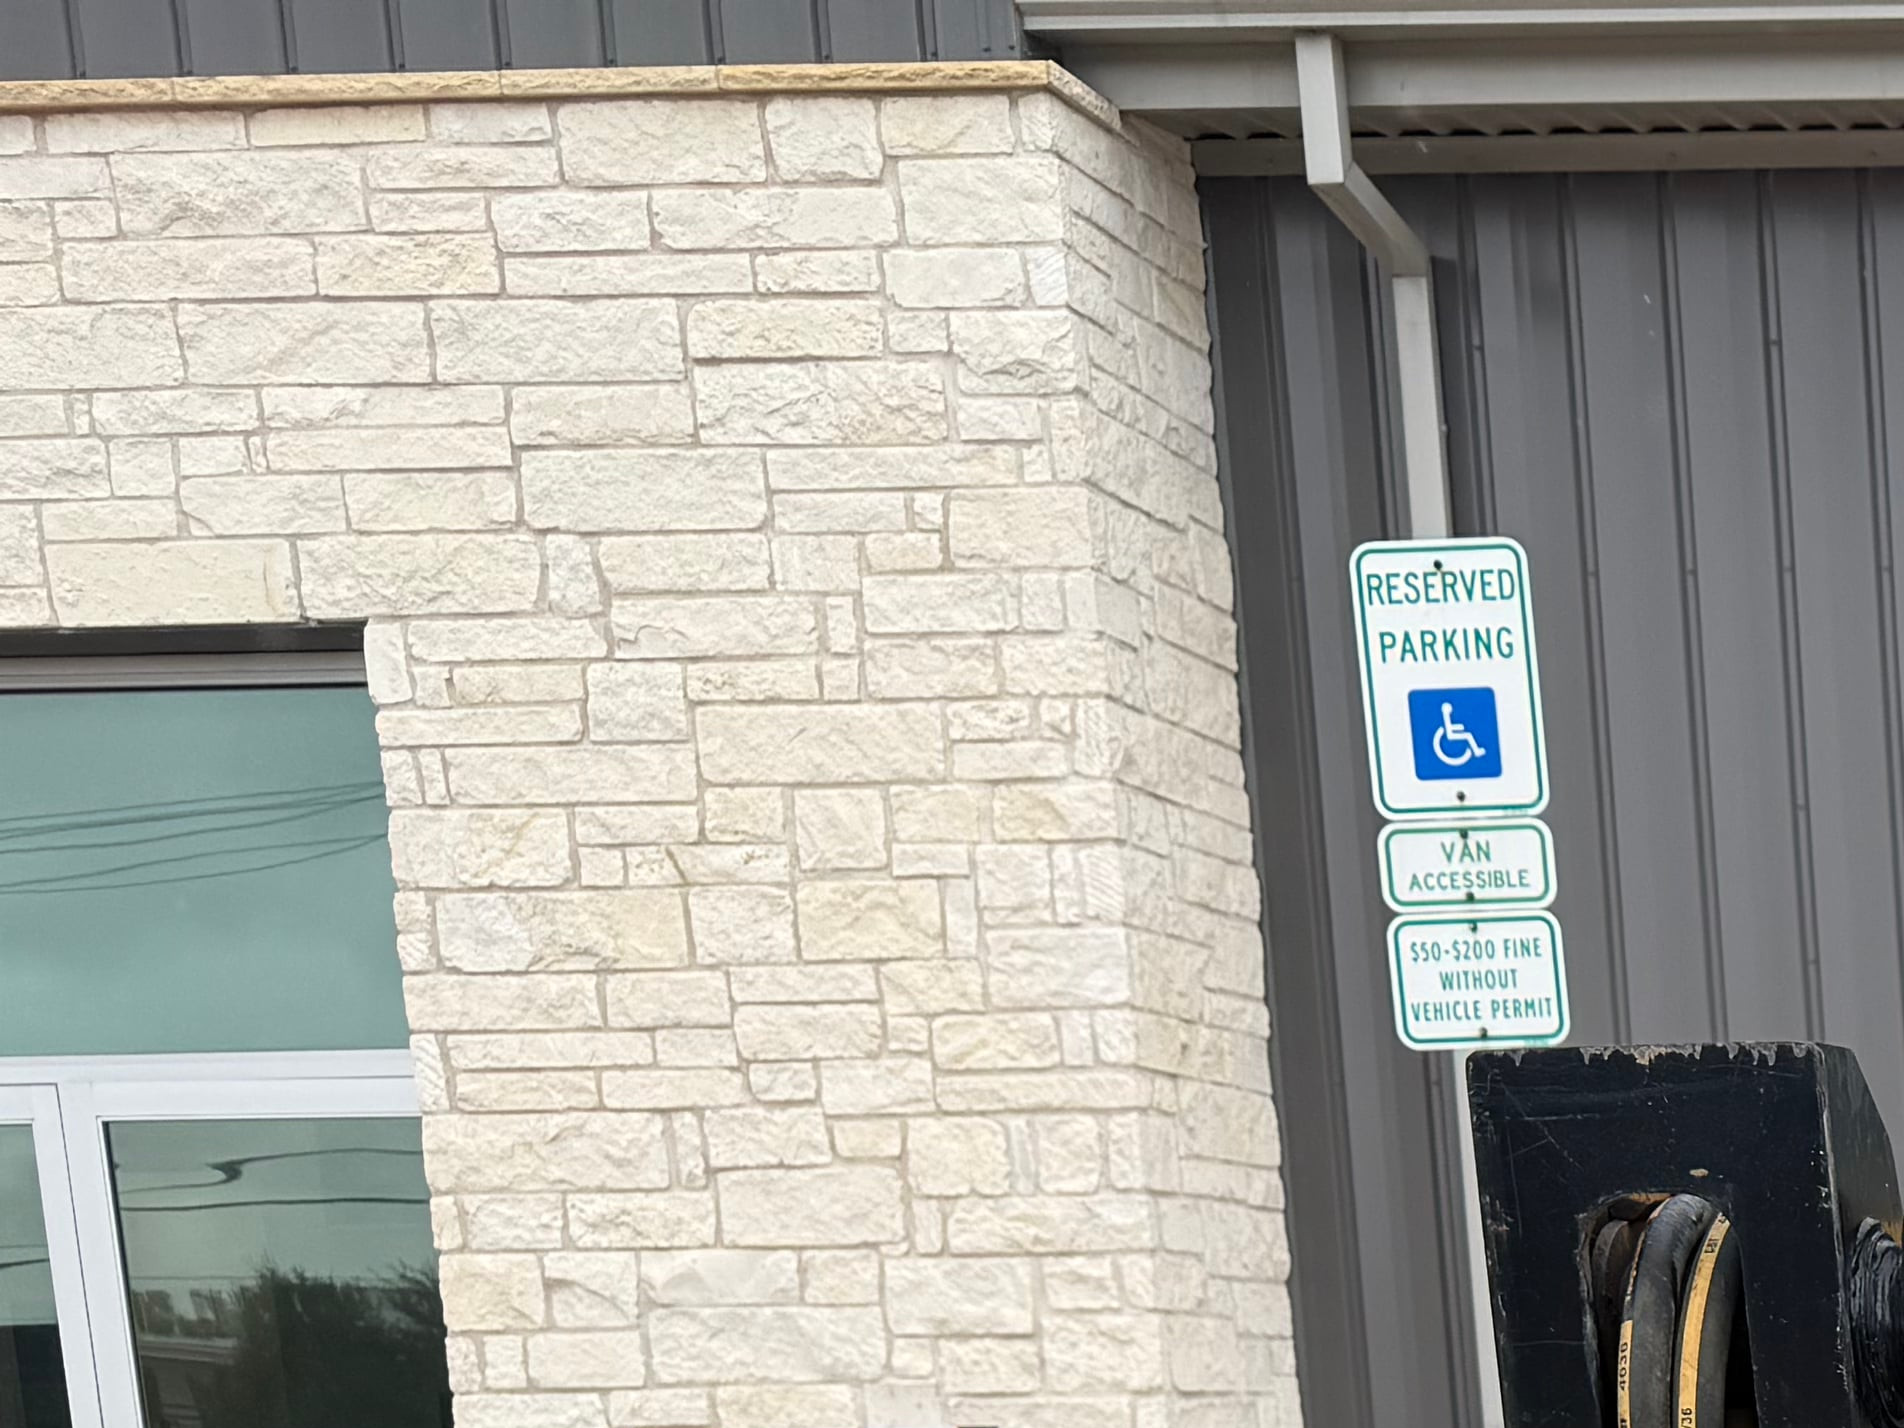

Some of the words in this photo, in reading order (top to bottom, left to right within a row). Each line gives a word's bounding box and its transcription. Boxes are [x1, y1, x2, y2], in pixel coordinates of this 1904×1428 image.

[1366, 567, 1516, 606] RESERVED
[1379, 627, 1515, 664] PARKING
[1441, 841, 1491, 864] VAN
[1409, 869, 1531, 891] ACCESSIBLE
[1410, 939, 1496, 963] $50-$200
[1503, 936, 1542, 959] FINE
[1439, 968, 1519, 991] WITHOUT
[1411, 1000, 1482, 1023] VEHICLE
[1491, 997, 1552, 1021] PERMIT
